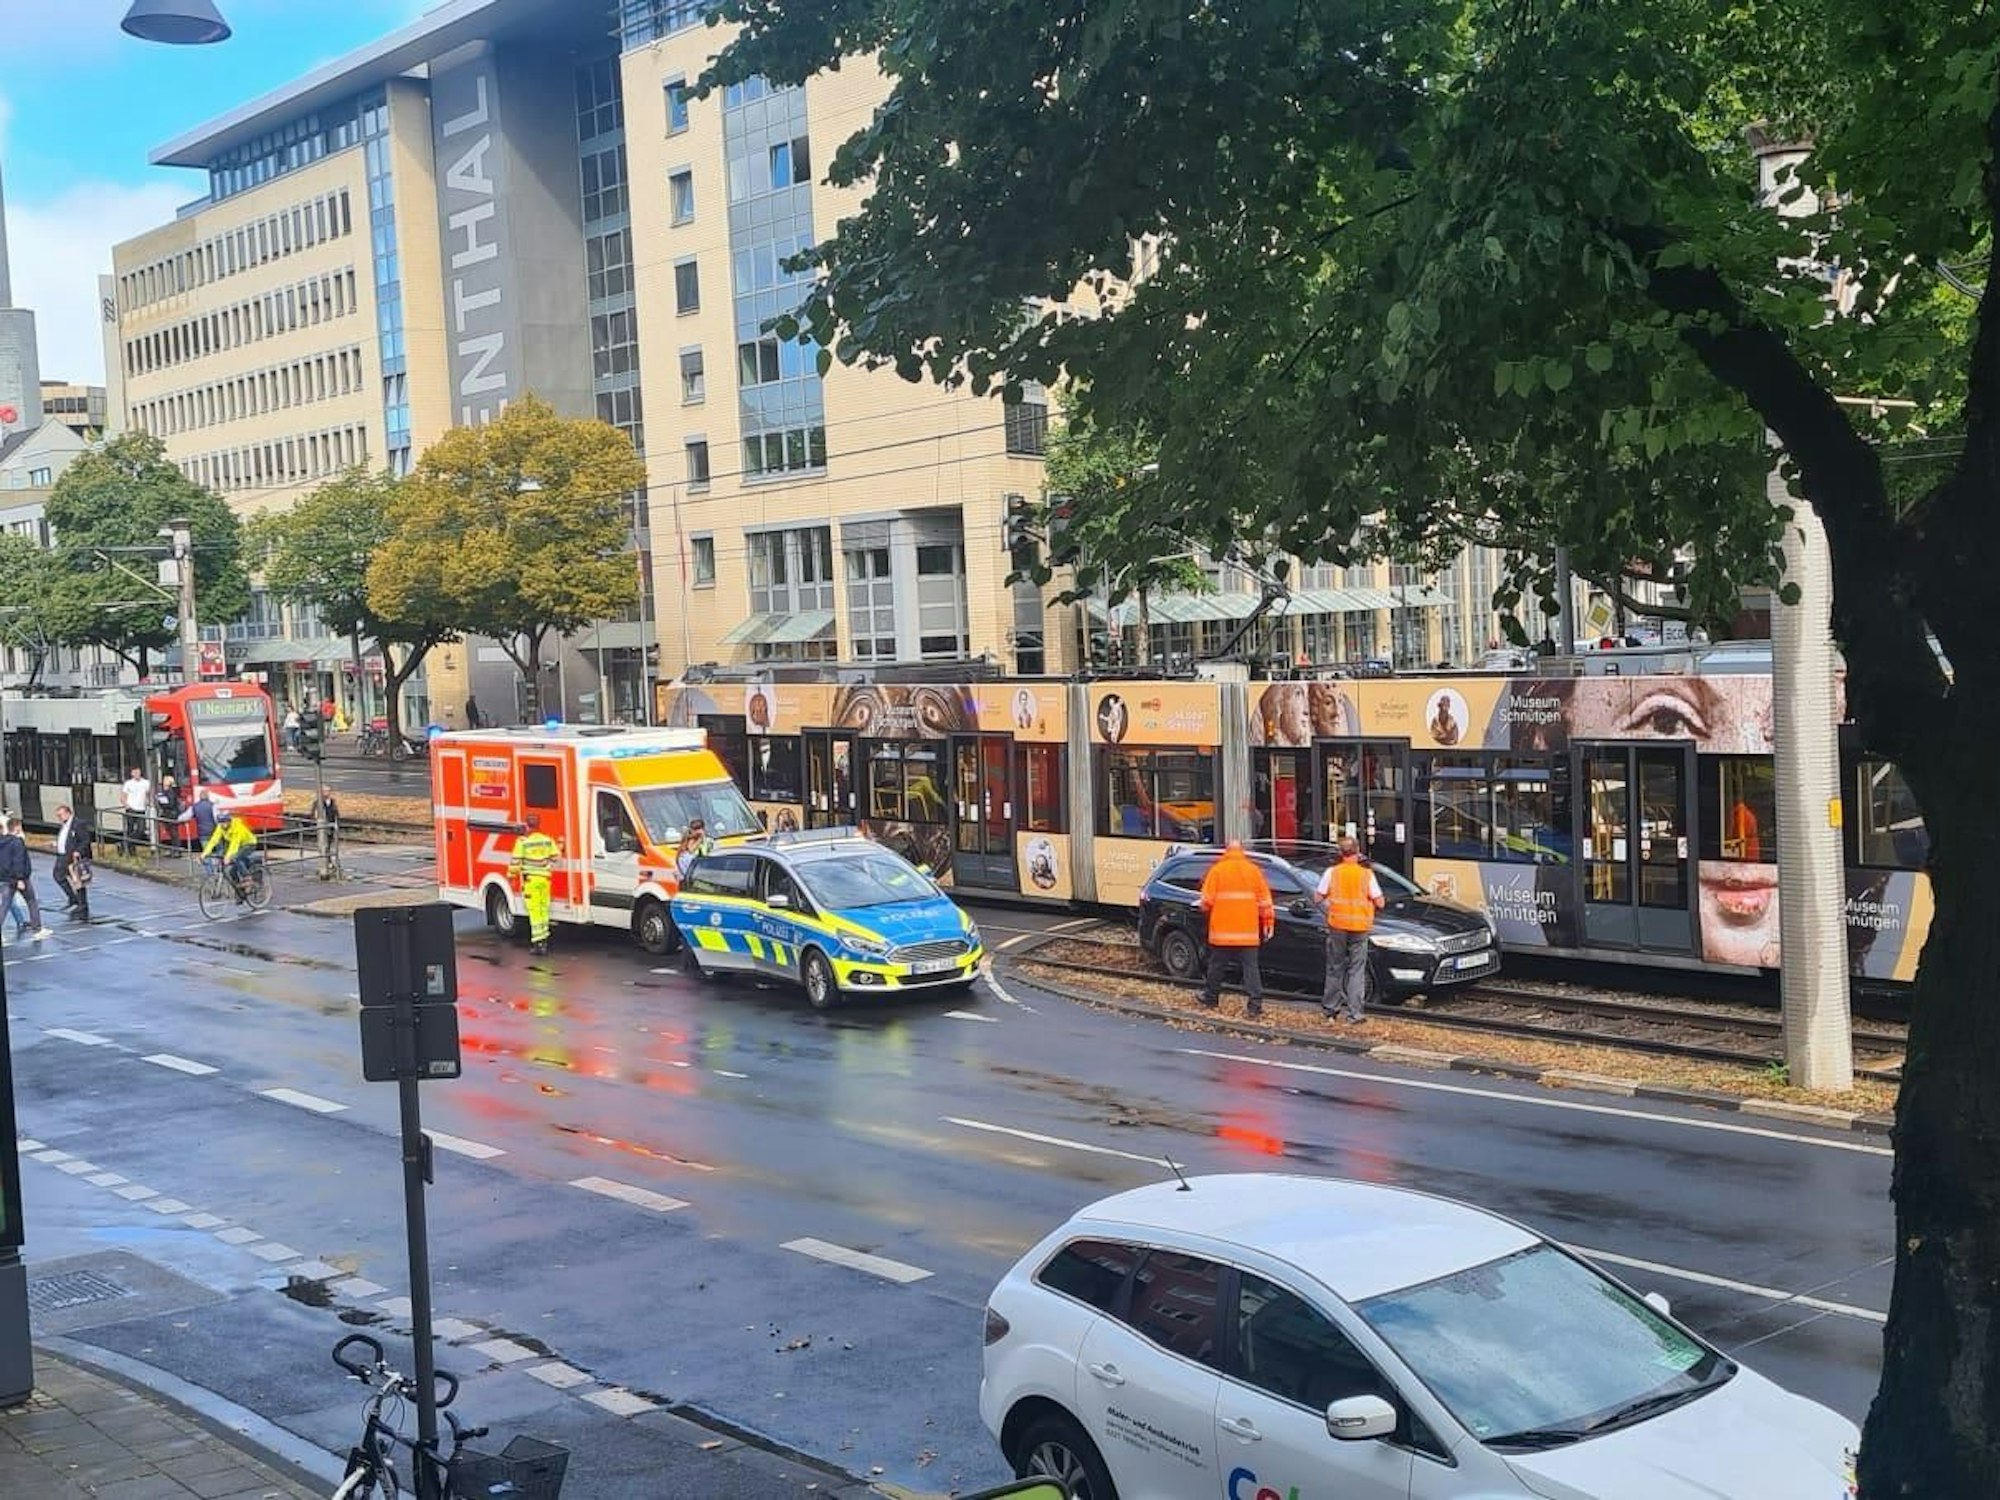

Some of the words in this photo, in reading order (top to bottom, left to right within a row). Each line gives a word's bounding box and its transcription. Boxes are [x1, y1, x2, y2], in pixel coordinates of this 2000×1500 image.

[1510, 694, 1561, 709] Museum
[1499, 708, 1562, 725] Schnütgen
[1489, 884, 1556, 905] Museum
[1486, 901, 1557, 926] chnütgen
